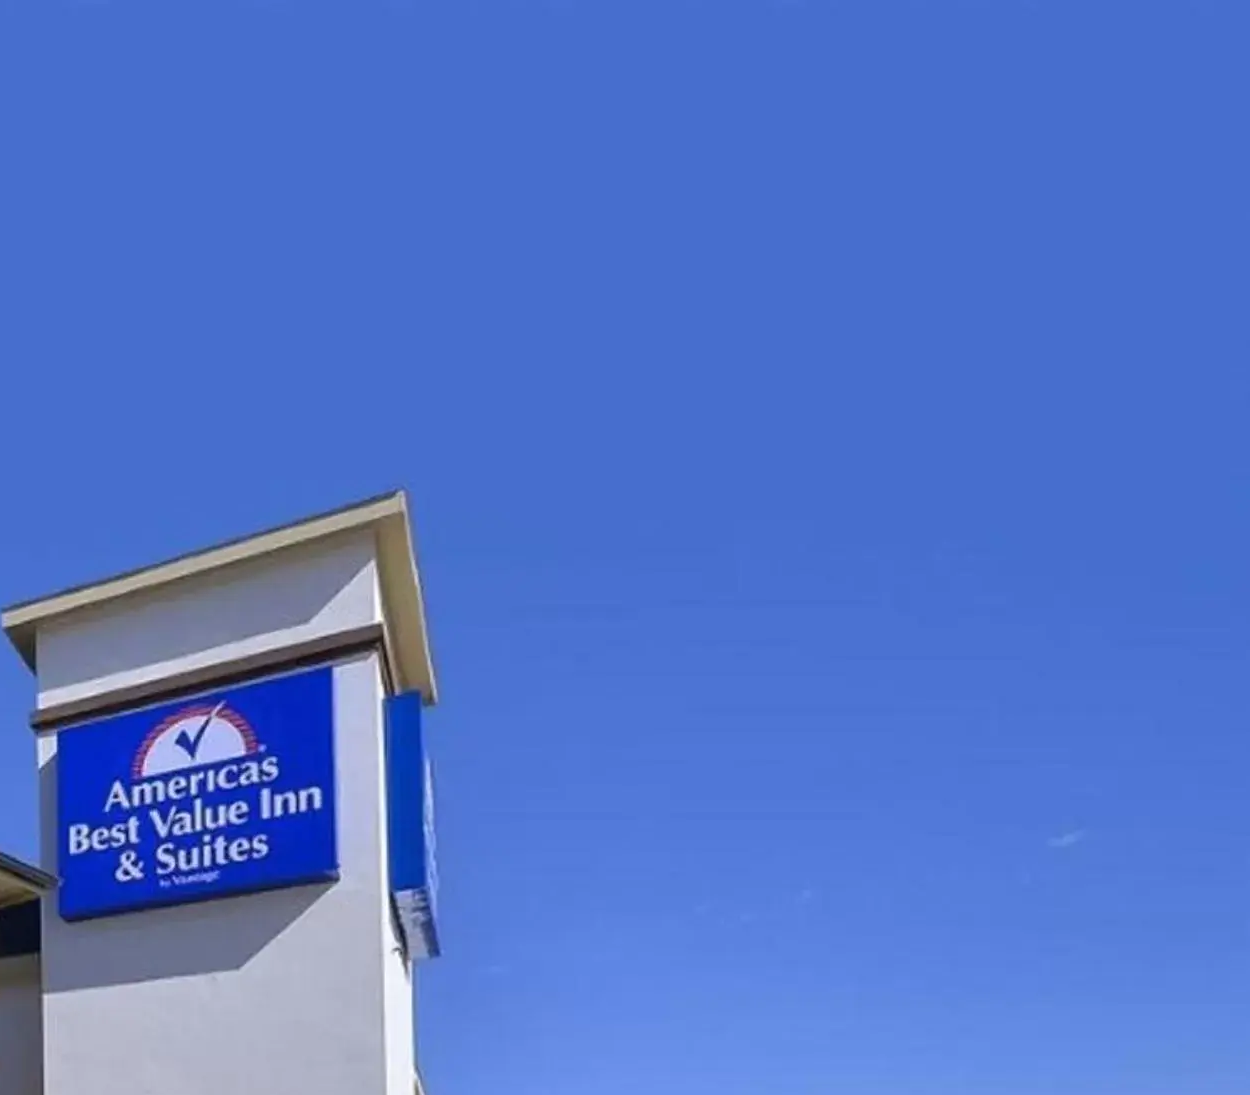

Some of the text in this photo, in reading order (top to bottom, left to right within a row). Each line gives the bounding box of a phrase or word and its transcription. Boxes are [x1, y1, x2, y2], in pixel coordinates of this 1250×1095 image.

[104, 755, 278, 812] Americas
[69, 785, 322, 855] Best Value Inn
[115, 833, 269, 882] & Suites
